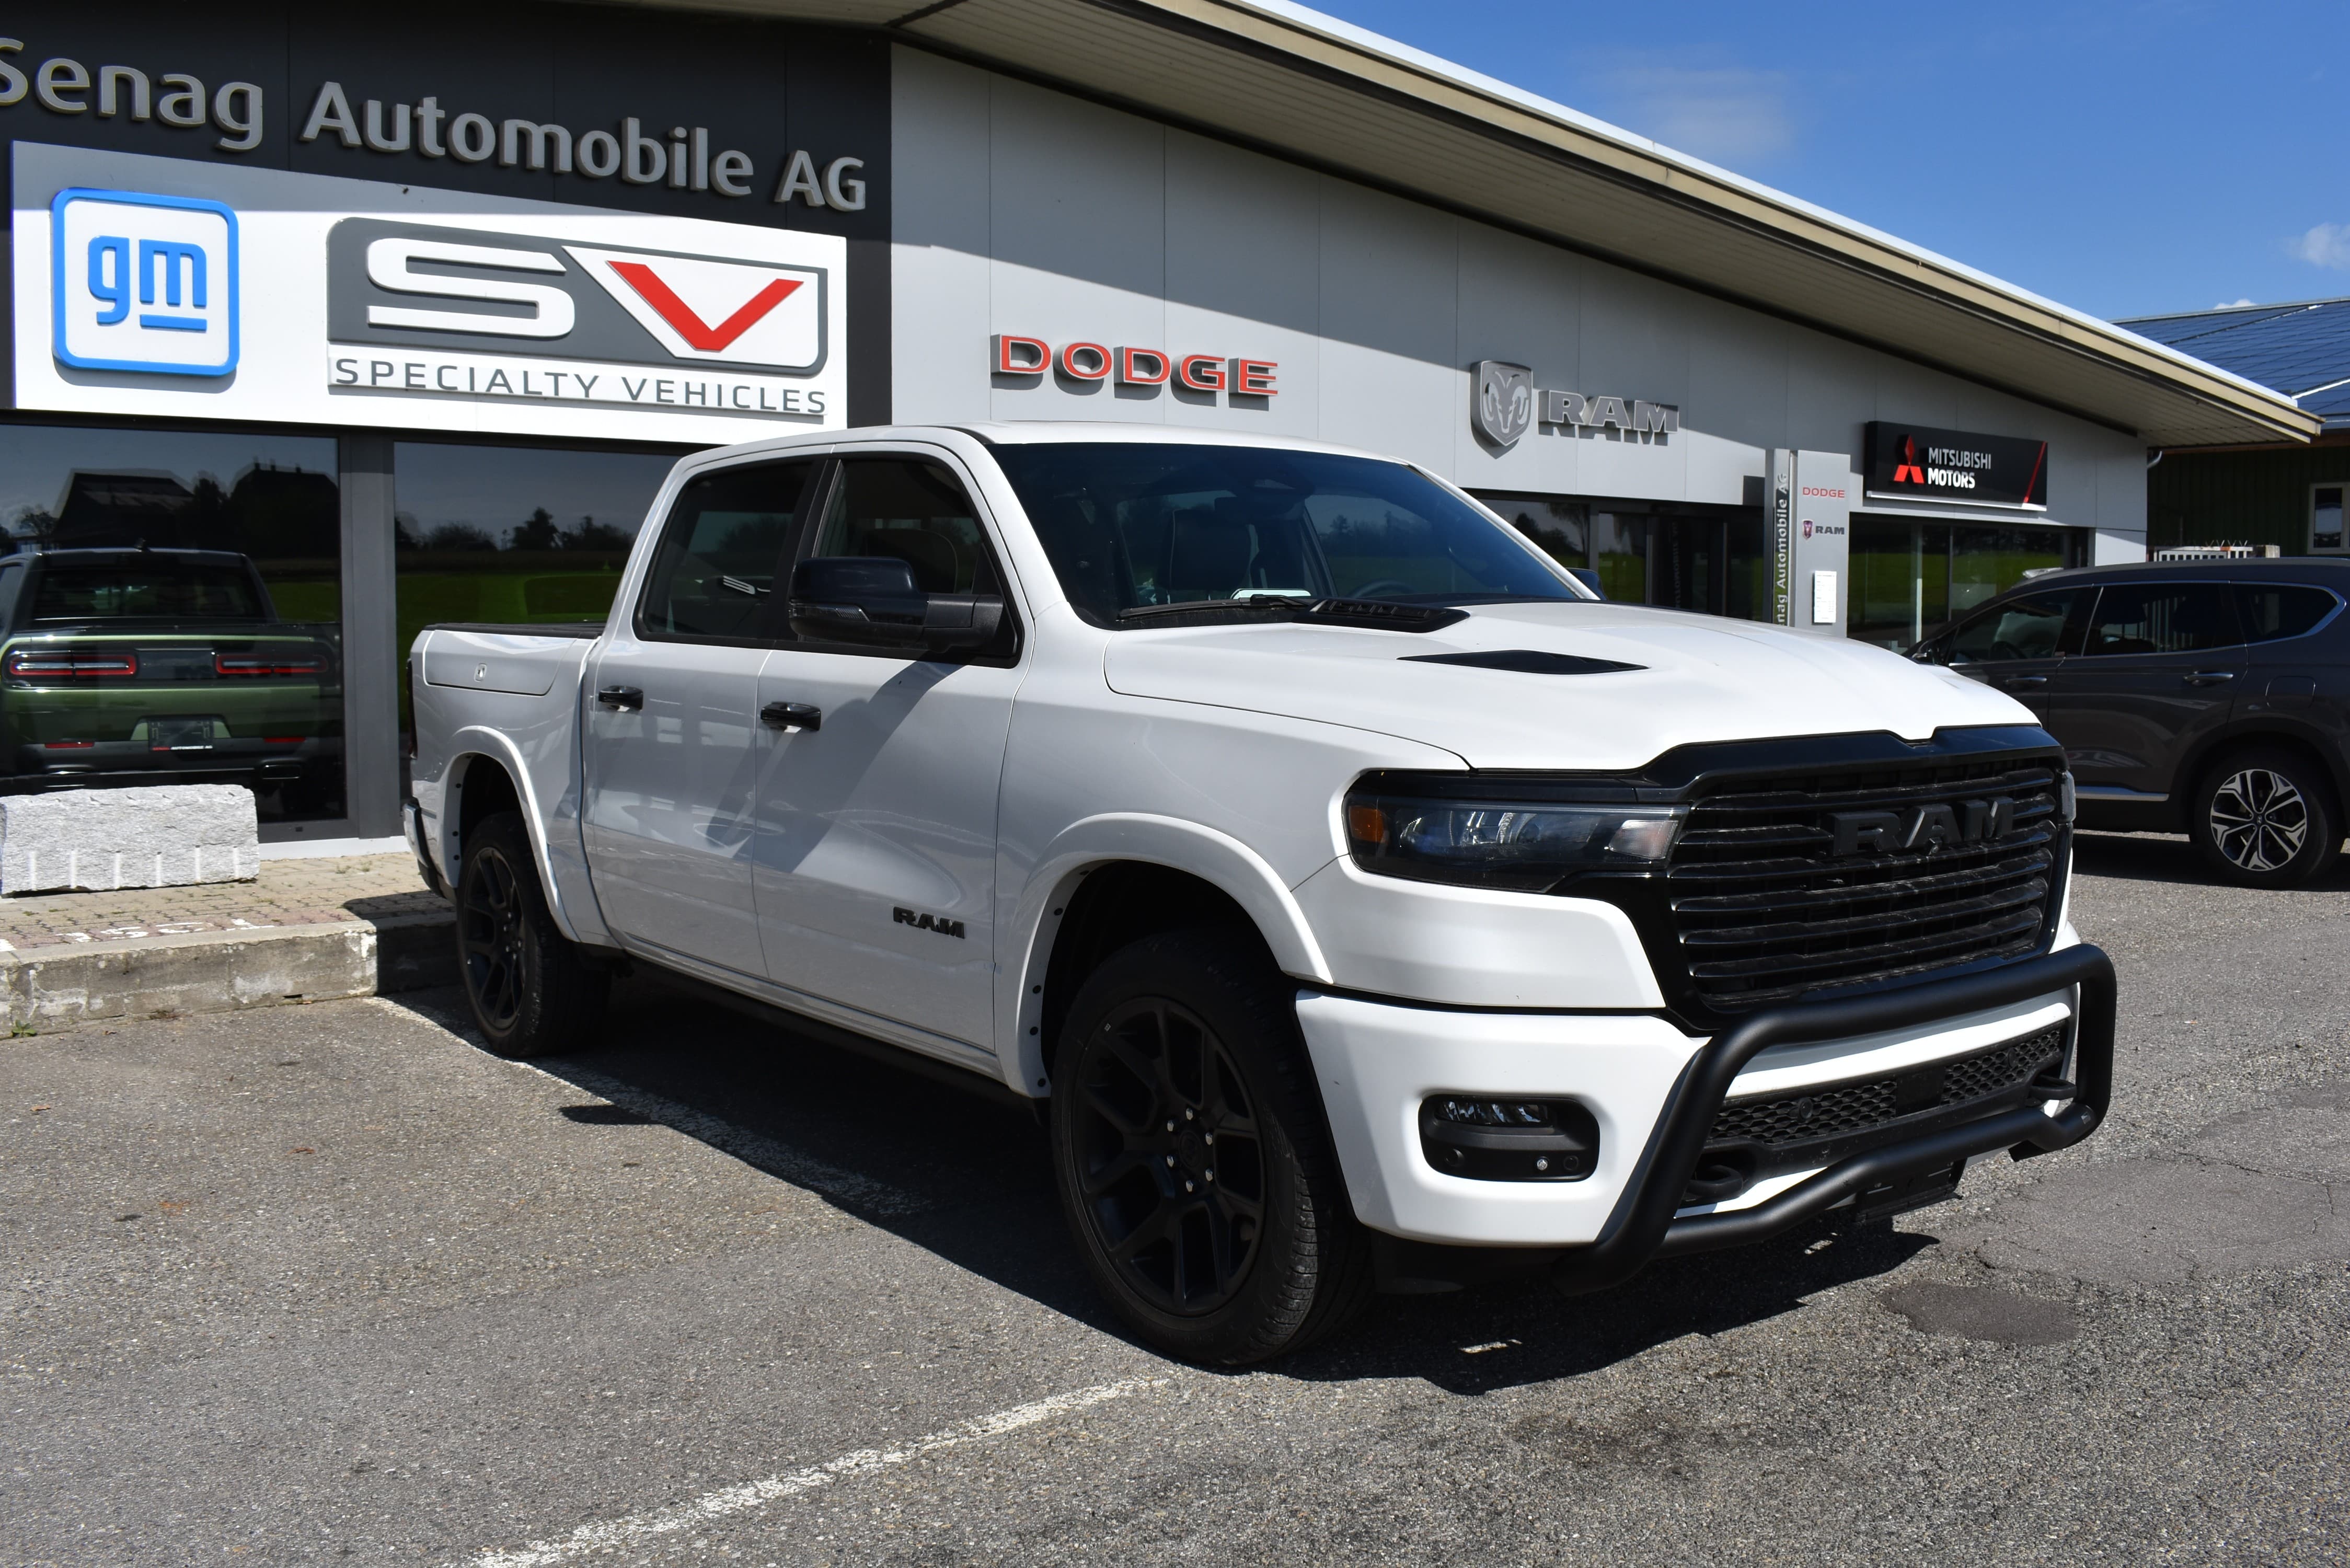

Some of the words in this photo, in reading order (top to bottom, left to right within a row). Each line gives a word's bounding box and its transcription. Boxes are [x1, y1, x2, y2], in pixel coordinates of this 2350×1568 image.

[0, 38, 263, 152] Senag
[299, 81, 754, 197] Automobile
[774, 149, 866, 211] AG
[88, 235, 207, 332] gm
[366, 237, 808, 358] SV
[336, 359, 600, 399] SPECIALTY
[621, 376, 825, 414] VEHICLES
[995, 334, 1278, 395] DODGE
[1543, 390, 1679, 433] RAM
[1927, 467, 1976, 489] MOTORS
[1928, 447, 1991, 469] MITSUBISHI
[1802, 487, 1846, 498] DODGE
[1777, 499, 1787, 589] Automobile
[1815, 525, 1845, 535] RAM
[1777, 594, 1788, 626] nag
[1831, 795, 2014, 856] RAM
[893, 906, 965, 939] RAM
